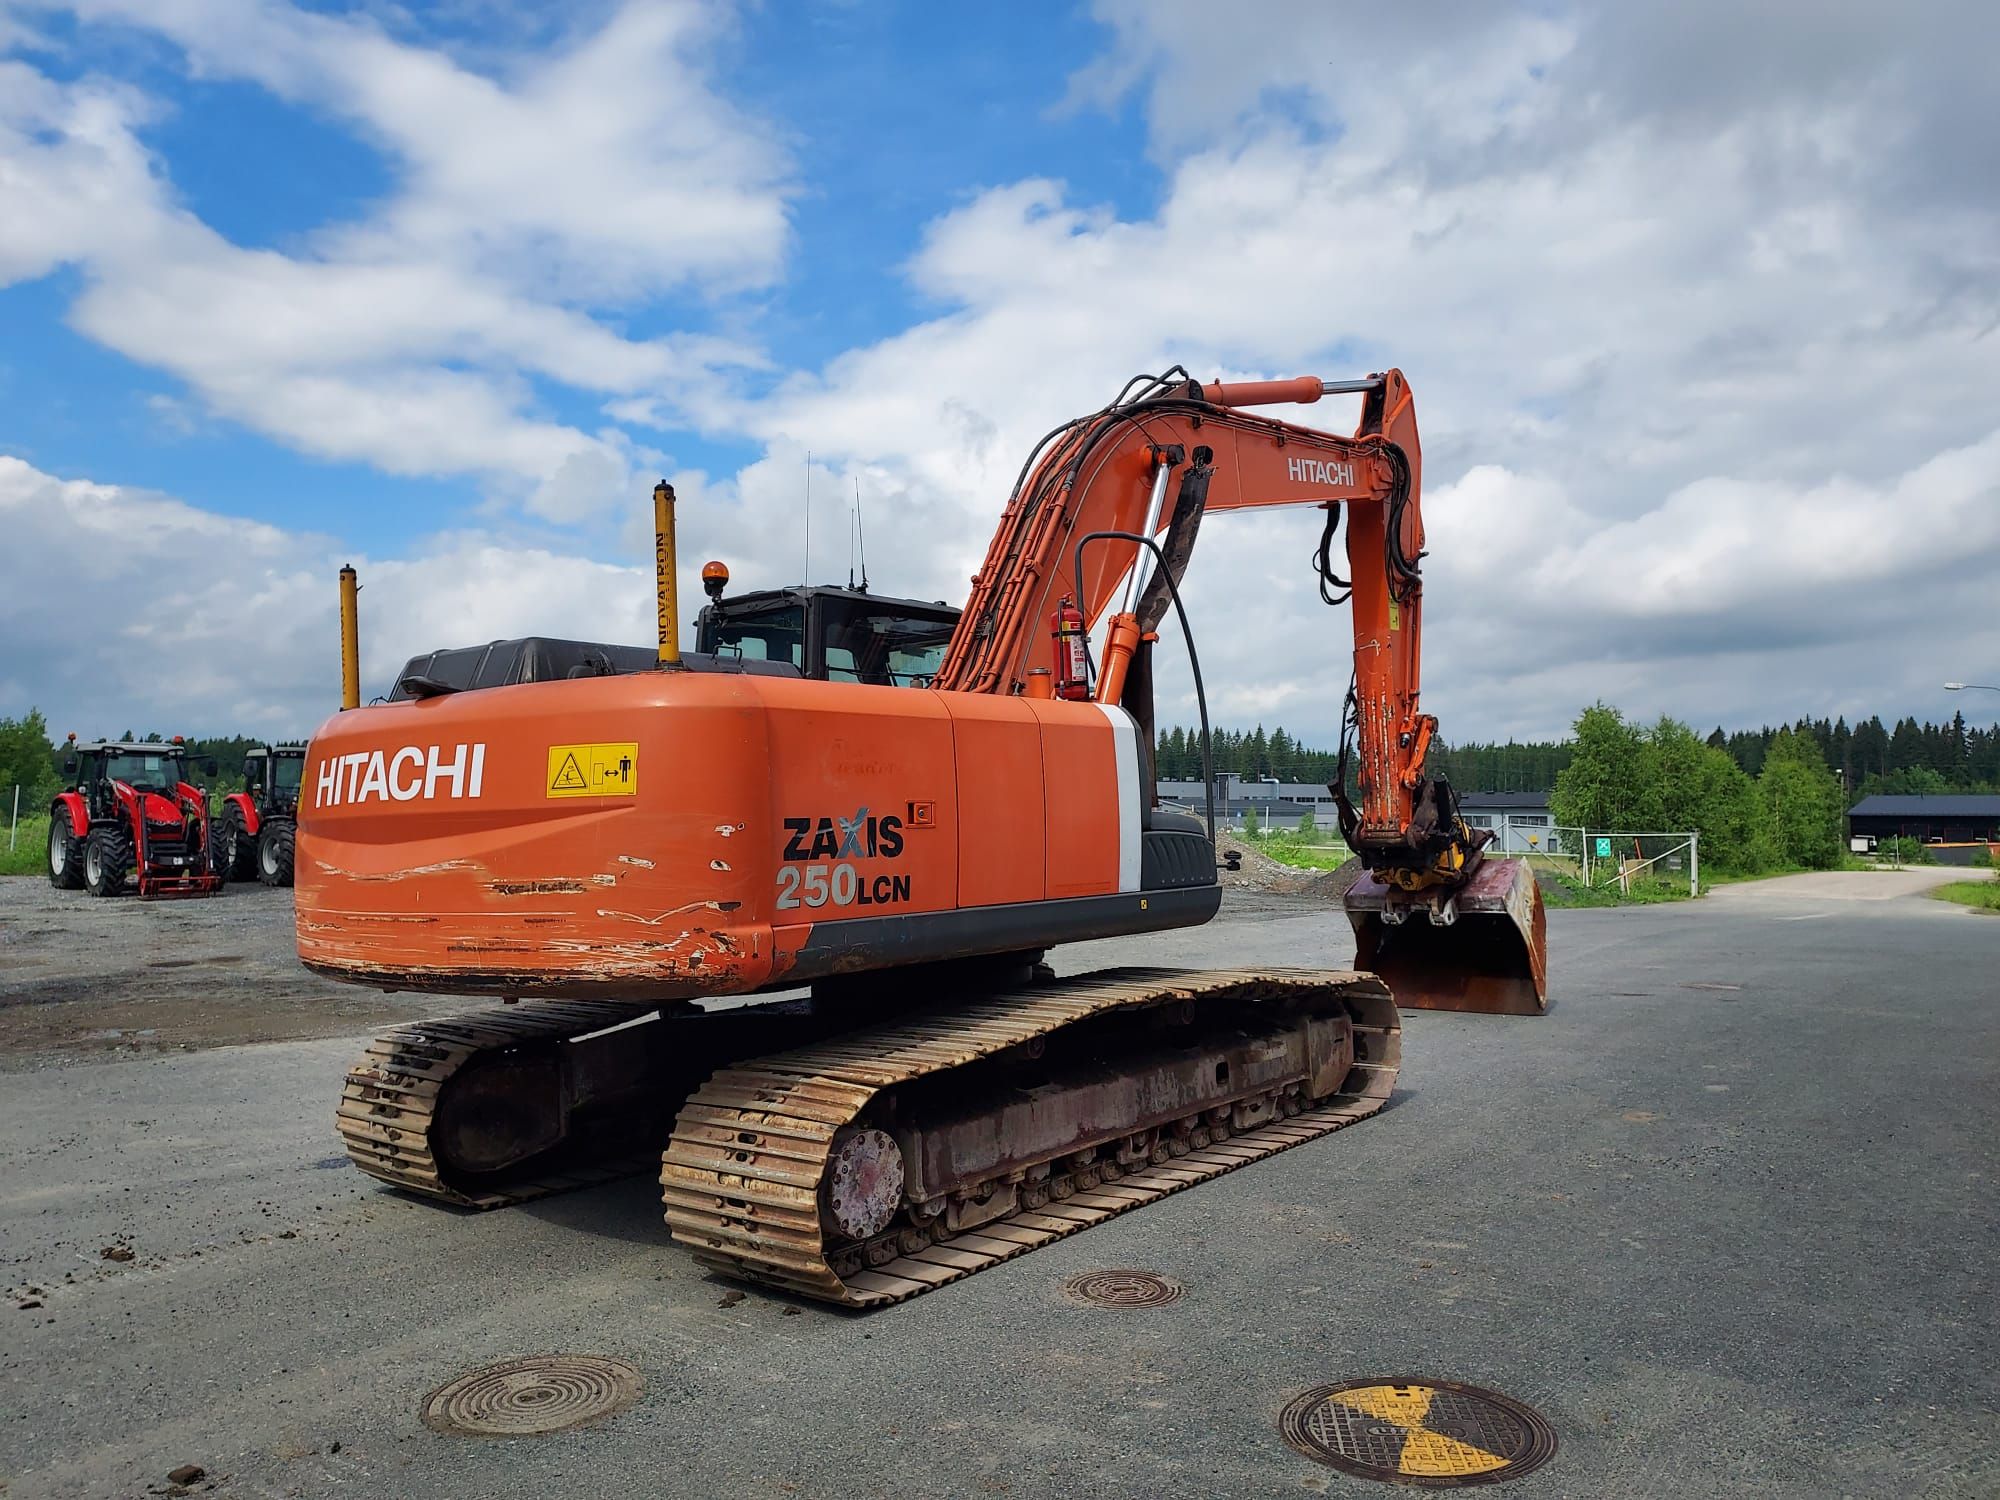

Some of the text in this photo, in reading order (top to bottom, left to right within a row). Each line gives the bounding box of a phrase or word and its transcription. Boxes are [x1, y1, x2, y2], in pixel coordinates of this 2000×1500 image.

[1288, 457, 1354, 486] HITACHI
[655, 533, 671, 644] NOVATRON
[315, 743, 486, 809] HITACHI
[783, 808, 904, 861] ZAXIS
